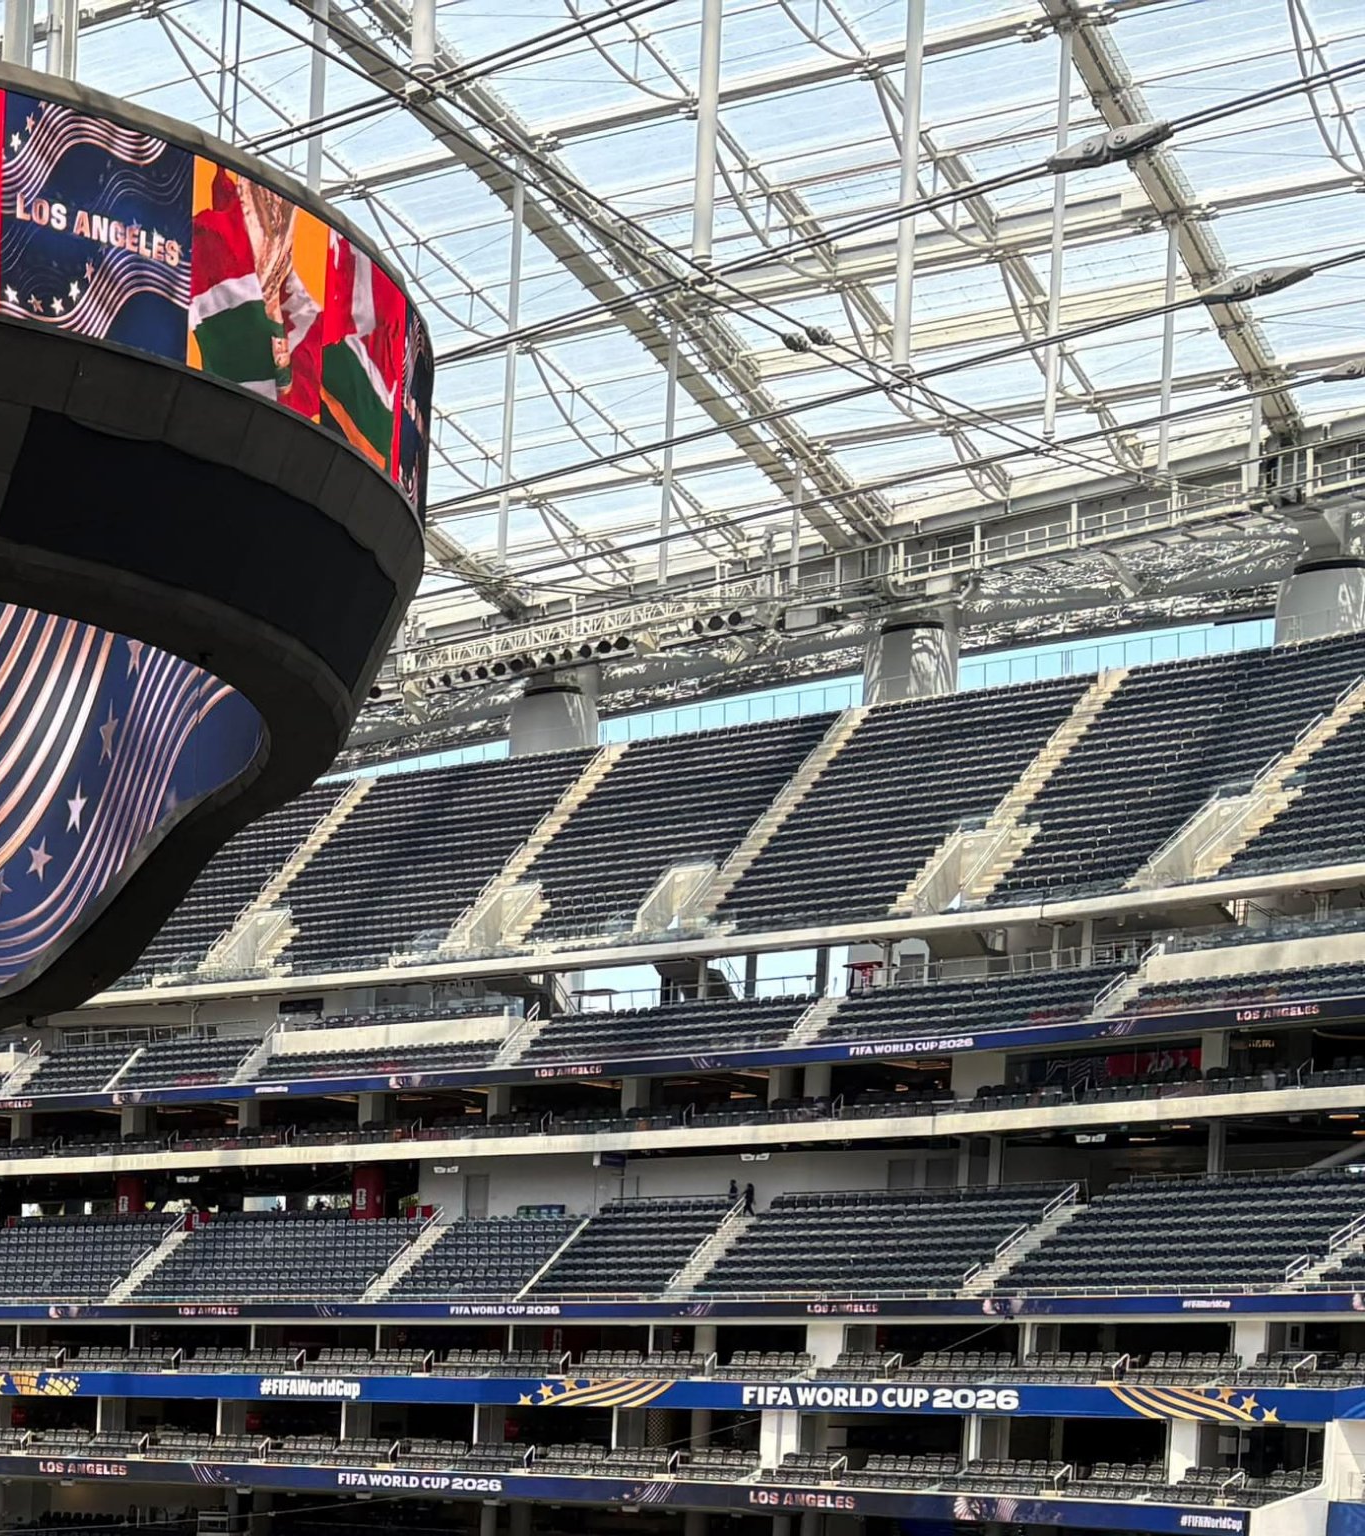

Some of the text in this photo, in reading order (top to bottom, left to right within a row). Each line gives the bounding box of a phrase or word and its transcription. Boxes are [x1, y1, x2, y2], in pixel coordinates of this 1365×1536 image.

[16, 192, 180, 267] LOS ANGELES
[1236, 1005, 1319, 1021] LOS ANGELES
[849, 1037, 973, 1056] FIFA WORLD CUP 2026
[449, 1305, 560, 1315] FIFA WORLD CUP 2026
[260, 1378, 361, 1400] #FIFAWorldCup
[742, 1386, 1020, 1411] FIFA WORLD CUP 2026
[39, 1461, 127, 1475] LOS ANGELES
[338, 1473, 501, 1491] FIFA WORLD CUP 2026
[749, 1491, 854, 1509] LOS ANGELES
